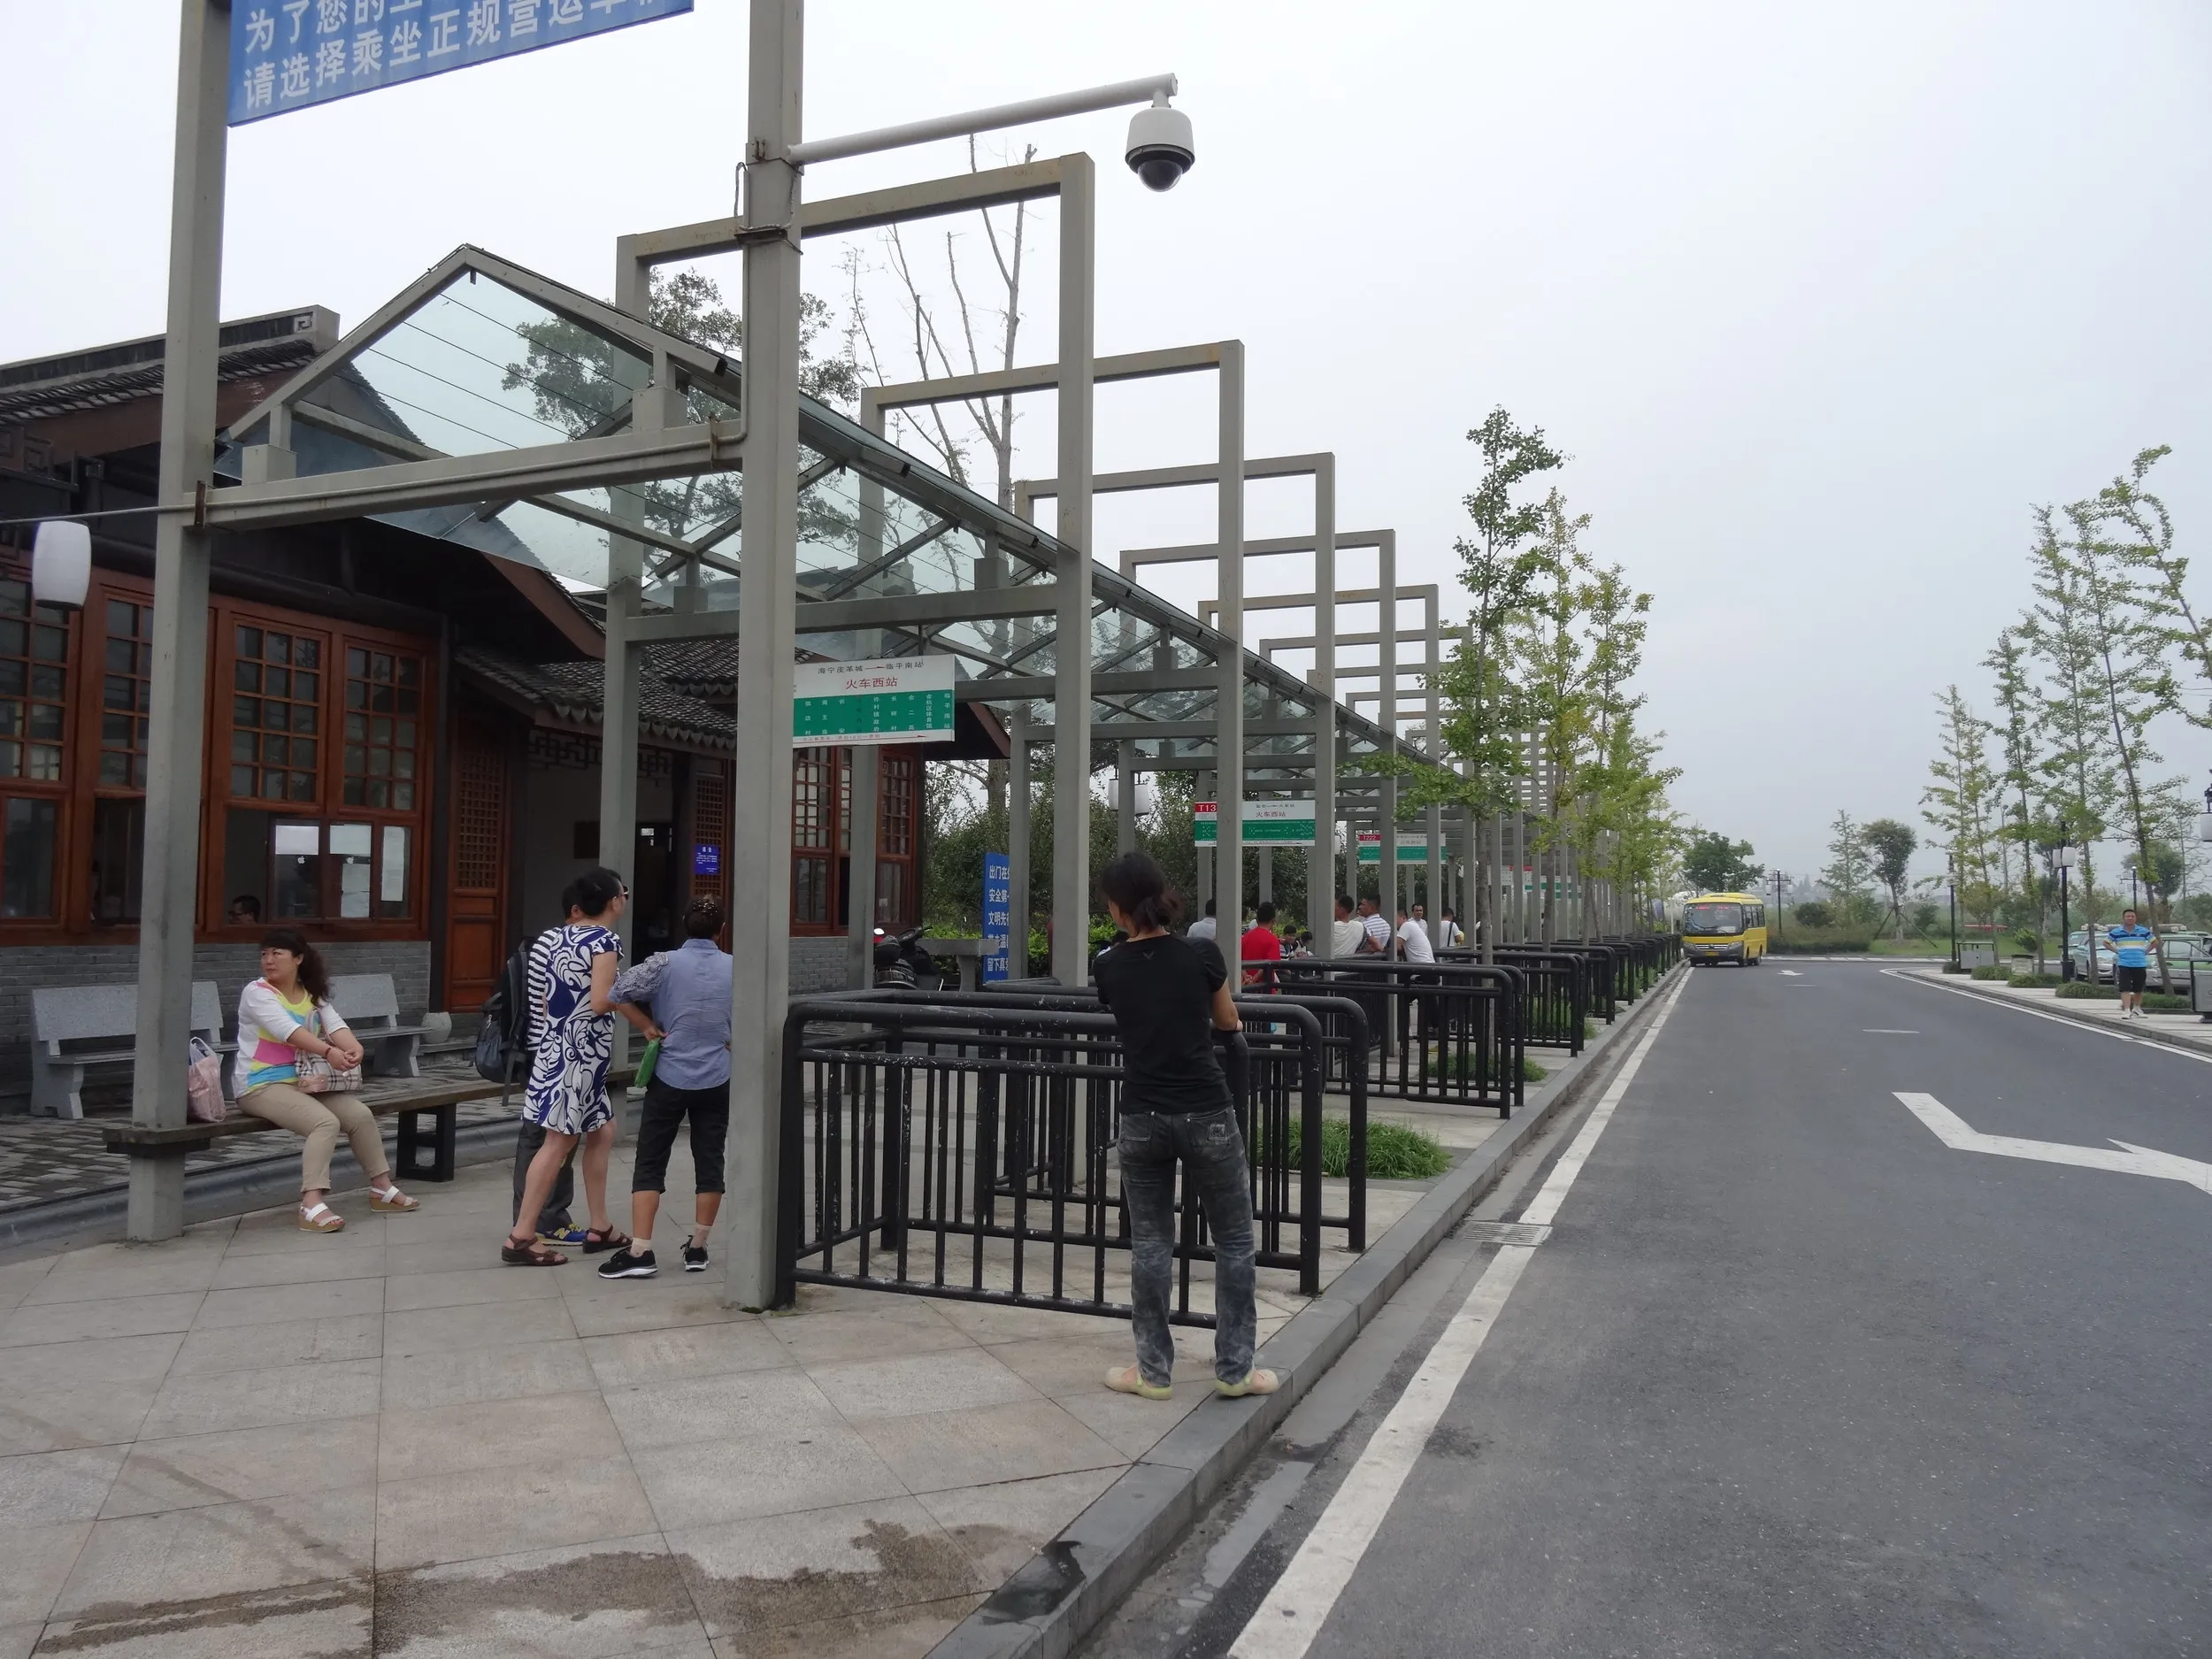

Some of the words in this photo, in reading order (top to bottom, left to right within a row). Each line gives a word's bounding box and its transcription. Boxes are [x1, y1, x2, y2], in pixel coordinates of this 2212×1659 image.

[243, 0, 653, 110] 请选择乘坐正规营运
[886, 661, 923, 670] 临平南站
[846, 677, 898, 689] 火车西站
[988, 888, 1010, 902] 安全第
